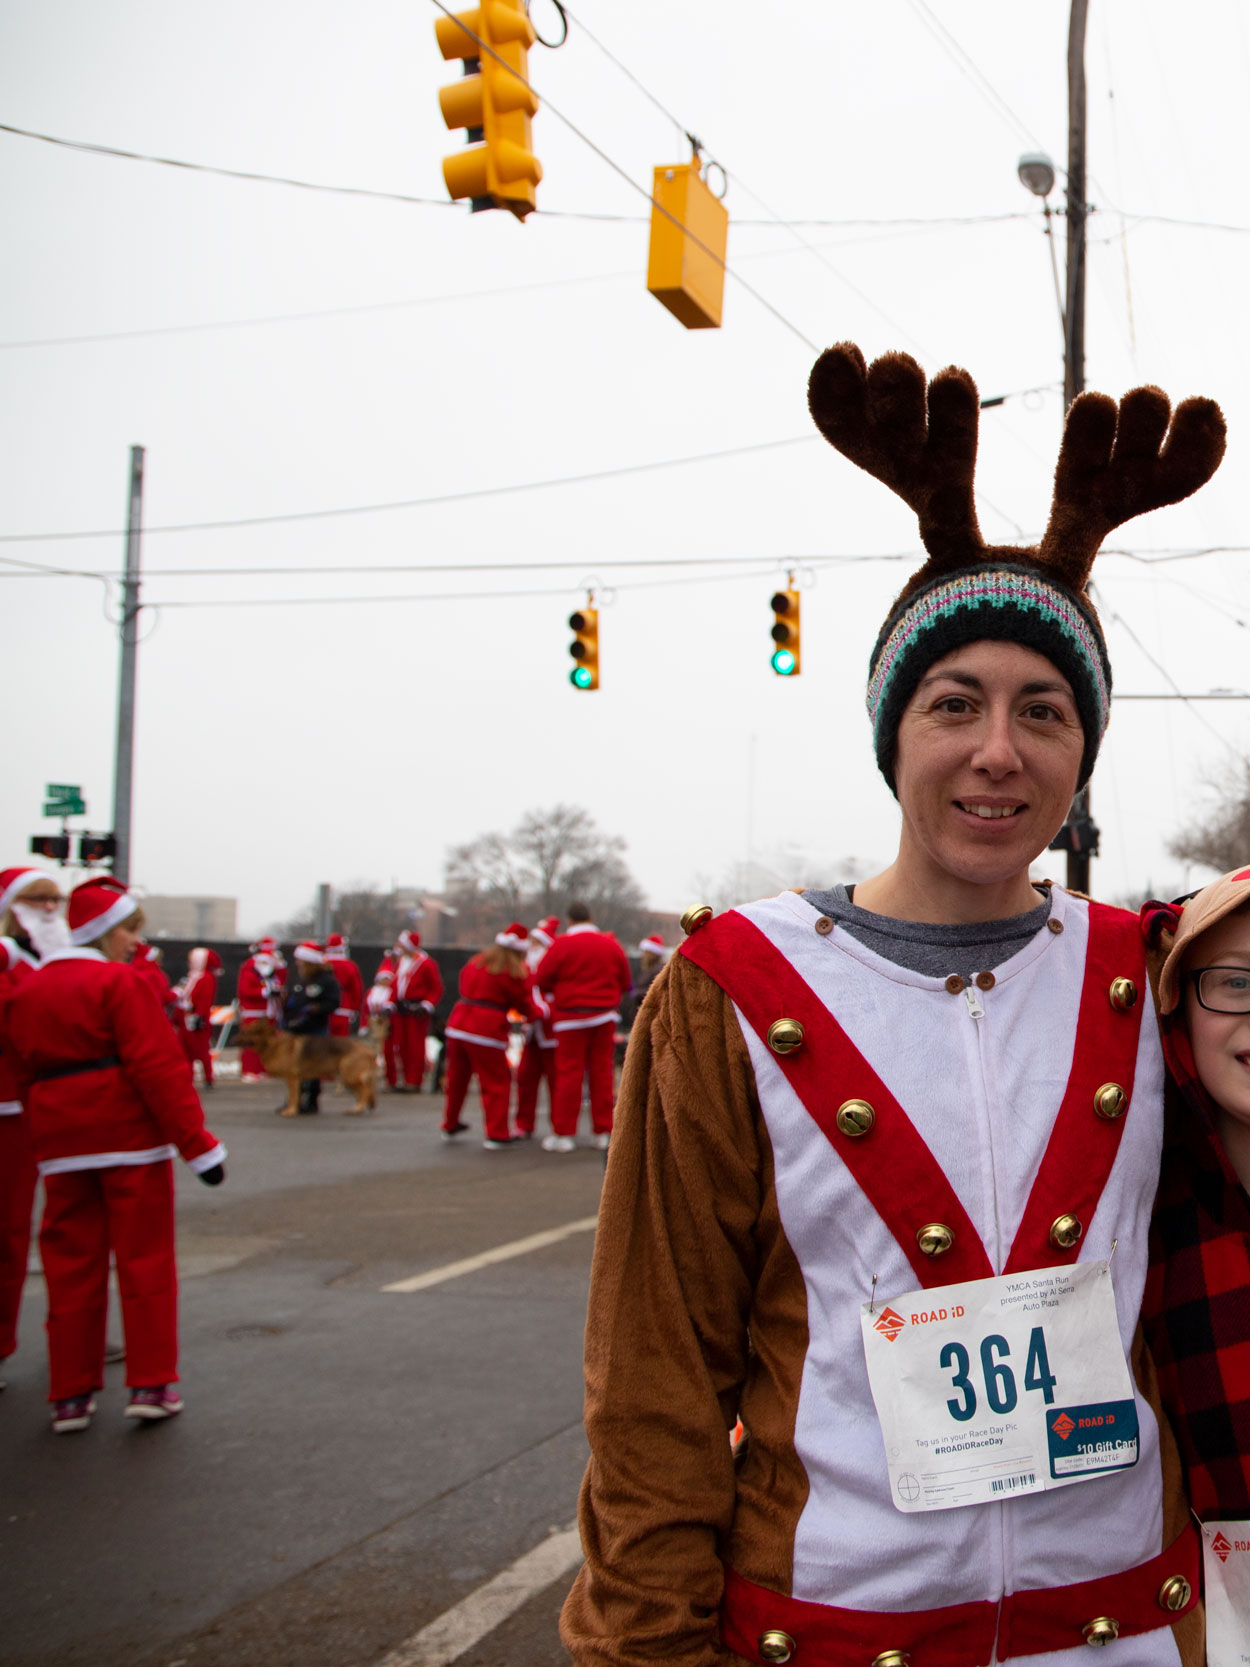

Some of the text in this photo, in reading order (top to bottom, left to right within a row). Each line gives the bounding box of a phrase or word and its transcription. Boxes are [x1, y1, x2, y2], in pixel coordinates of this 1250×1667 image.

[1006, 1276, 1069, 1293] YMCA Santa Run
[1000, 1286, 1075, 1306] presented by Al Serra
[1022, 1299, 1060, 1312] Auto Plaza
[911, 1305, 965, 1325] ROAD iD
[939, 1326, 1057, 1422] 364
[1078, 1414, 1115, 1429] ROAD iD
[915, 1439, 929, 1448] Tag
[950, 1432, 968, 1442] your
[969, 1430, 988, 1438] Race
[990, 1426, 1004, 1436] Day
[1005, 1423, 1018, 1432] Pic
[935, 1437, 1004, 1455] #ROADiDRaceDay
[1077, 1437, 1137, 1455] $10 Gift Card
